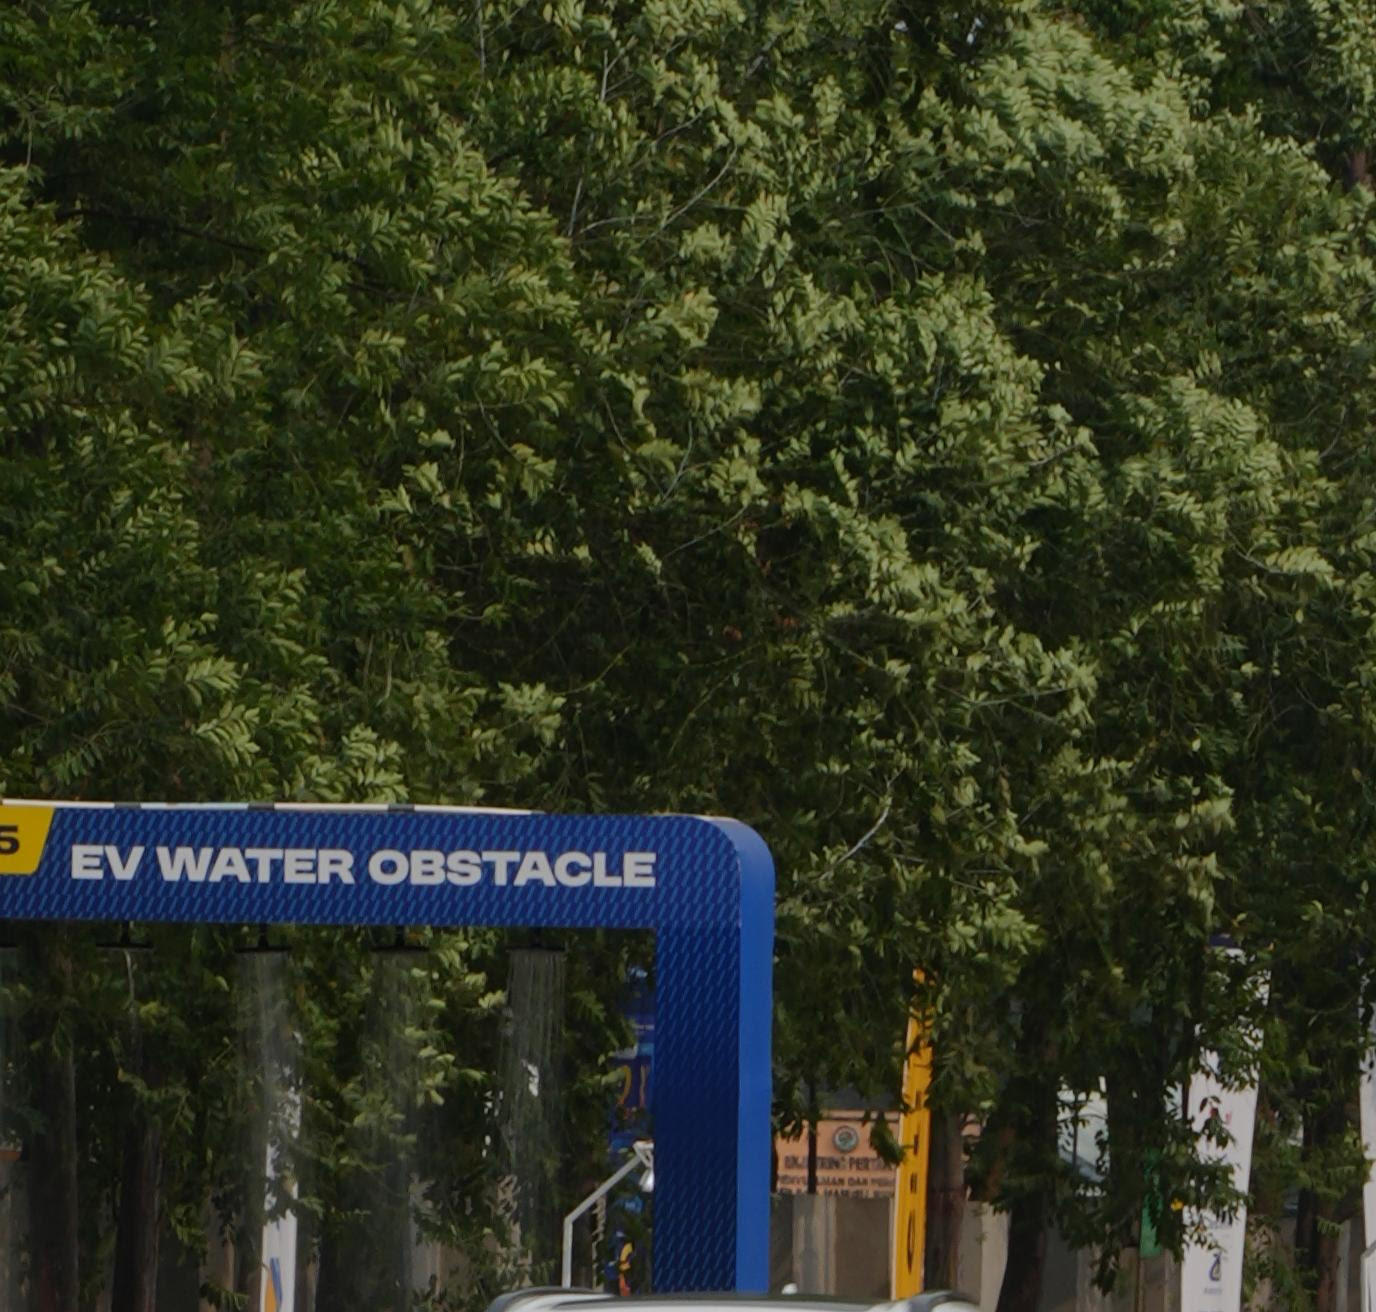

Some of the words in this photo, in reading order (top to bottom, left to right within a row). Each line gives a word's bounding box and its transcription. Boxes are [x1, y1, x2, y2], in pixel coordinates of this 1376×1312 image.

[70, 844, 145, 881] EV
[155, 846, 356, 885] WATER
[368, 850, 657, 888] OBSTACLE
